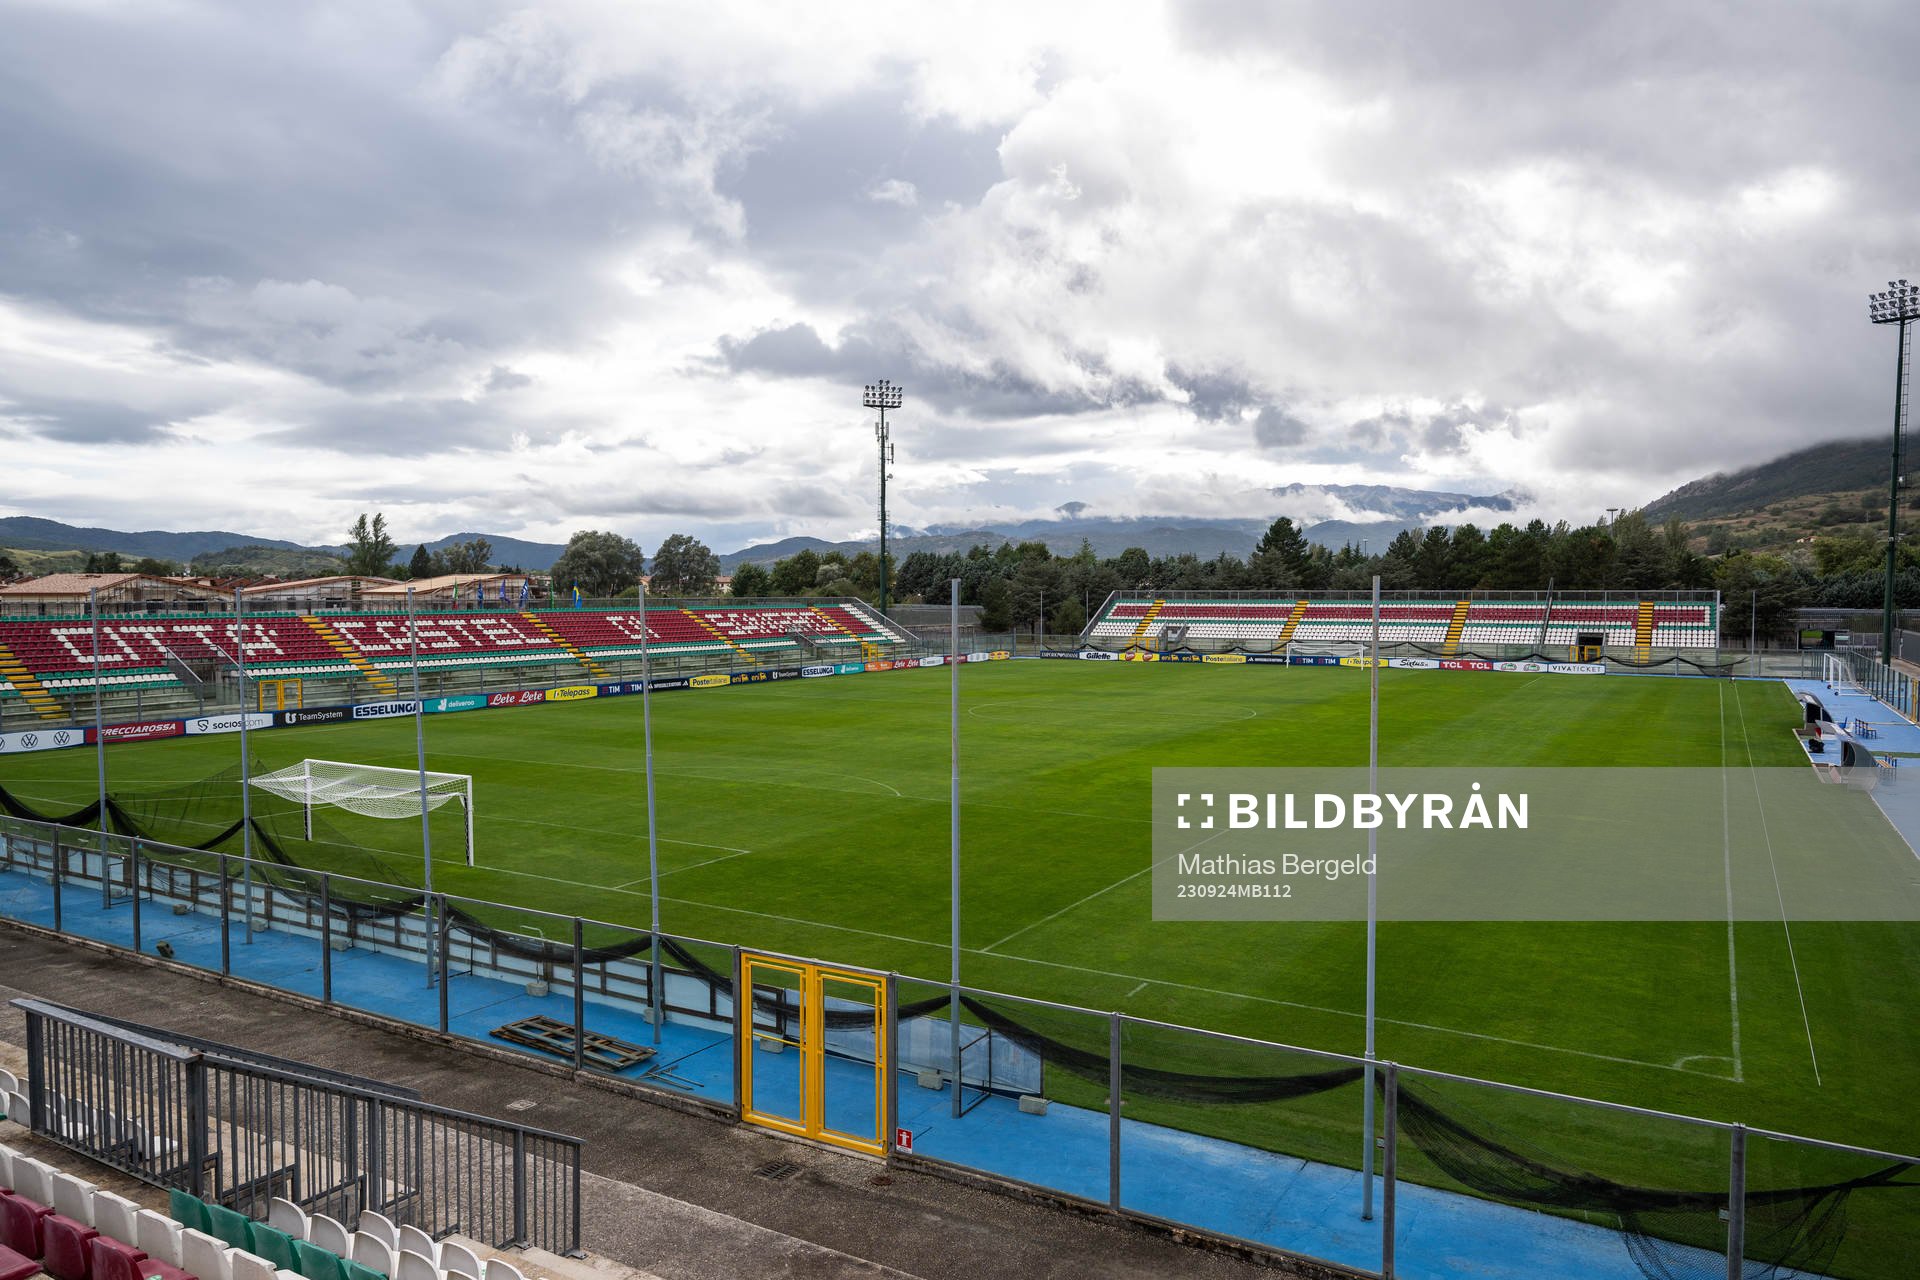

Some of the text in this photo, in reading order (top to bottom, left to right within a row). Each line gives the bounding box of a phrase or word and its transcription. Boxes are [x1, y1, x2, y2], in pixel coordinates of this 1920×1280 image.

[1086, 652, 1111, 660] Gillette
[1442, 661, 1463, 669] TCL
[1469, 662, 1490, 670] TCL
[1552, 665, 1601, 673] VIVATICKET
[803, 667, 834, 676] ESSELUNGA
[608, 685, 621, 694] TIM
[631, 683, 642, 692] TIM
[560, 687, 590, 699] Telepass
[489, 690, 543, 706] Lete Lete
[447, 698, 475, 708] deliveroo
[298, 709, 343, 722] TeamSystem
